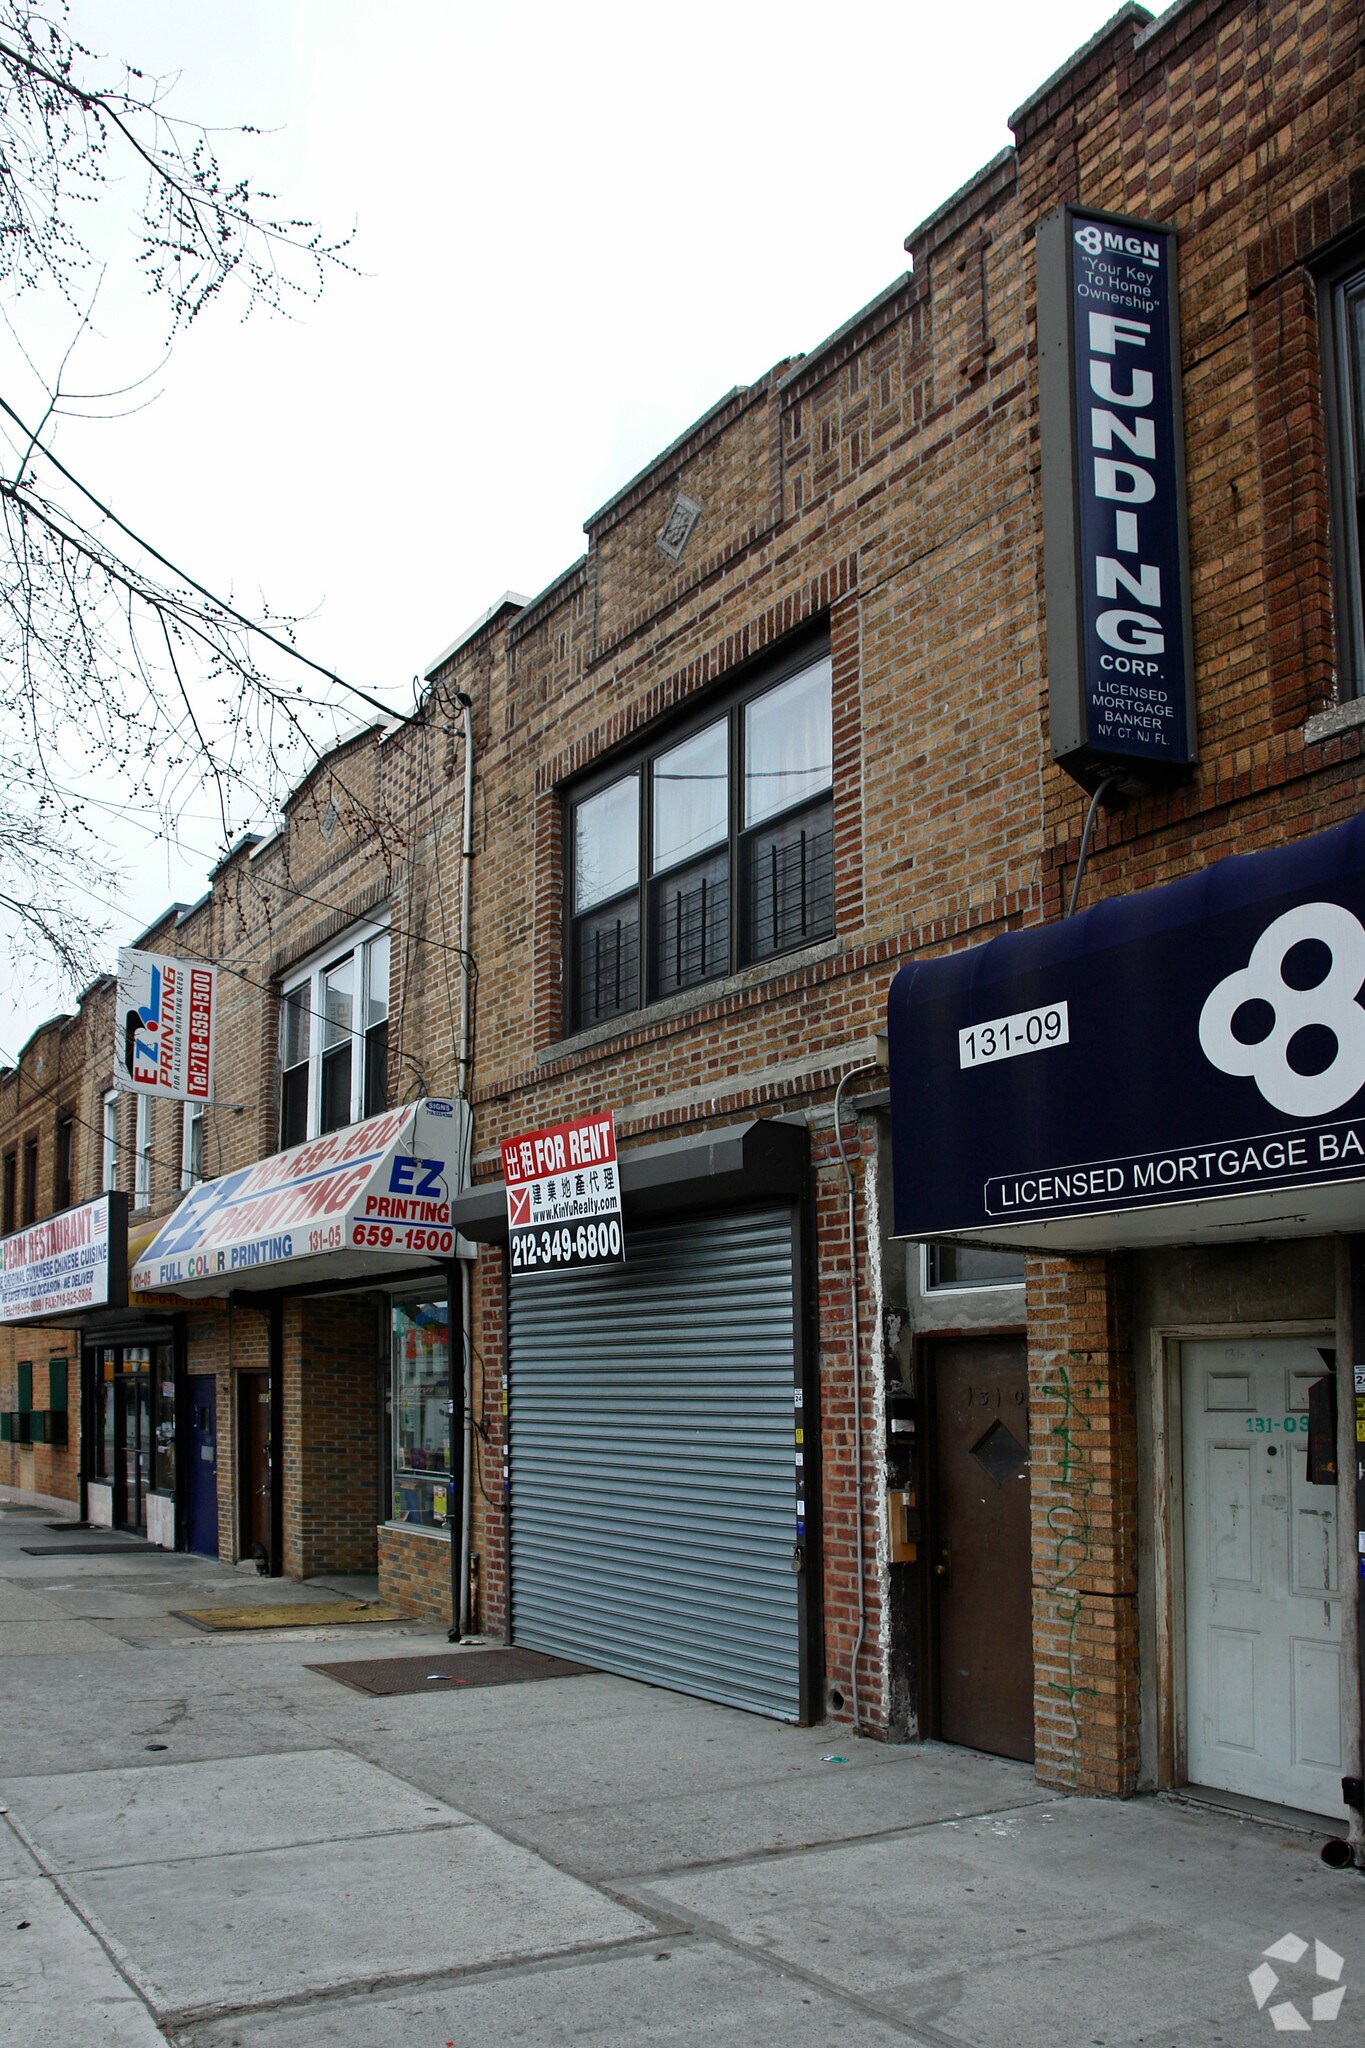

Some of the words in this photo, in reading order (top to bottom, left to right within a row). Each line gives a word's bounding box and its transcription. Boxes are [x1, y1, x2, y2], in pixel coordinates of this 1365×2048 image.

[1104, 231, 1160, 259] MGN
[1082, 256, 1122, 275] "Your
[1126, 266, 1154, 286] Key
[1085, 270, 1104, 286] To
[1109, 276, 1152, 297] Home
[1077, 283, 1160, 314] Ownership"
[1089, 311, 1165, 655] FUNDING
[1100, 654, 1165, 680] CORP.
[1092, 694, 1175, 718] MORTGAGE
[1097, 681, 1168, 702] LICENSED
[1104, 710, 1163, 730] BANKER
[176, 970, 184, 996] NEEDS
[160, 966, 176, 1088] PRINTING
[175, 997, 183, 1034] PRINTING
[190, 973, 210, 1091] Tel:718-659-1500
[964, 1010, 1062, 1061] 131-09
[134, 1039, 158, 1085] EZ
[173, 1074, 181, 1090] FOR
[428, 1102, 451, 1112] SIGNS
[240, 1108, 412, 1196] 718-659-1500
[505, 1142, 535, 1181] 出租
[534, 1134, 567, 1174] FOR
[569, 1121, 610, 1166] RENT
[388, 1155, 446, 1198] EZ
[1001, 1167, 1125, 1207] LICENSED
[1133, 1138, 1308, 1189] MORTGAGE
[139, 1167, 254, 1263] EZ
[197, 1164, 373, 1248] PRINTING
[365, 1195, 450, 1223] PRINTING
[532, 1195, 618, 1223] www.KinYuRealty.com
[4, 1234, 27, 1271] PEARL
[29, 1208, 92, 1263] RESTAURANT
[159, 1261, 183, 1283] FULL
[187, 1250, 225, 1278] COLOR
[231, 1233, 293, 1269] PRINTING
[308, 1224, 342, 1252] 131-05
[352, 1223, 454, 1252] 659-1500
[512, 1221, 620, 1267] 212-349-6800
[26, 1258, 53, 1282] GUYANESE
[54, 1251, 79, 1275] CHINESE
[80, 1242, 107, 1267] CUISINE
[29, 1284, 37, 1297] ALL
[63, 1277, 71, 1290] WE
[71, 1270, 94, 1288] DELIVER
